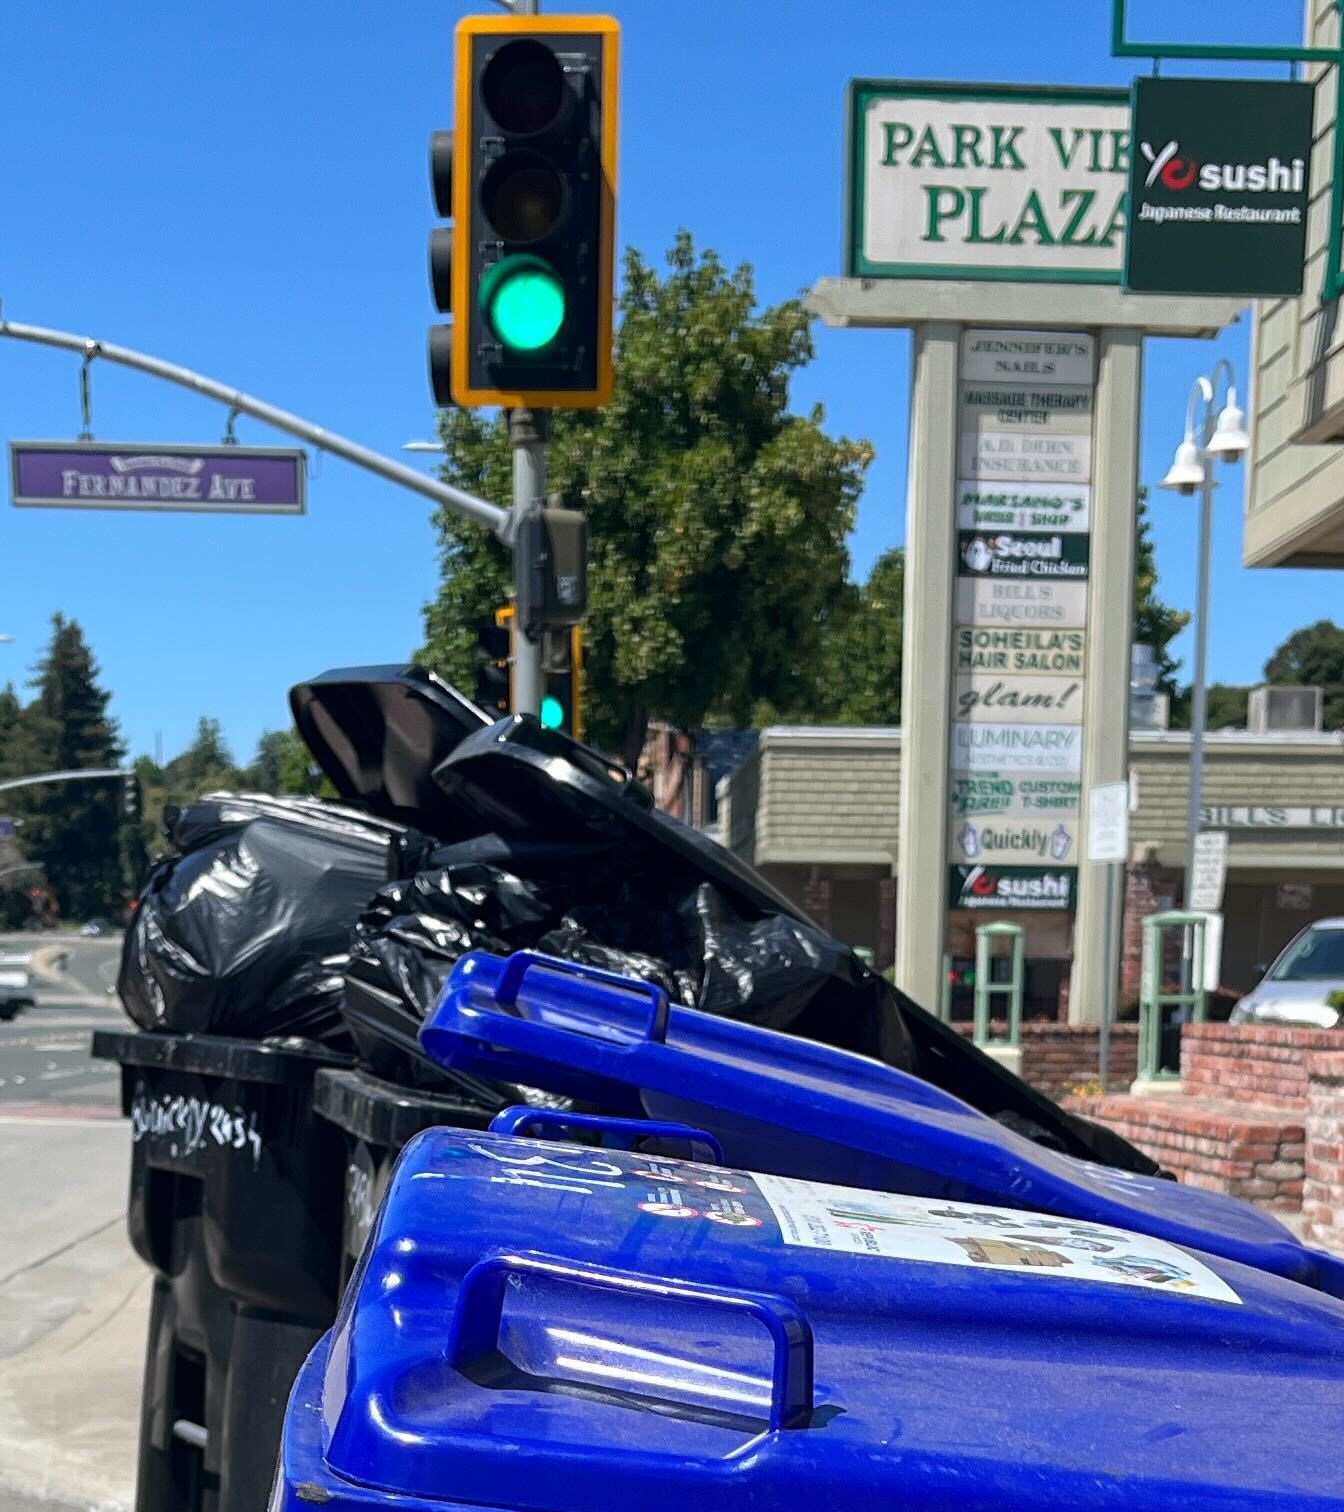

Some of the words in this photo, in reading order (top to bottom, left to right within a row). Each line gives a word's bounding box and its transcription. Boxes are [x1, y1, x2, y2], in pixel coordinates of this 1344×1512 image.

[881, 122, 1026, 171] PARK
[1050, 128, 1130, 171] VIE
[1199, 157, 1304, 192] sushi
[922, 186, 1127, 247] PLAZA
[1138, 203, 1213, 224] Japanese
[1214, 203, 1302, 224] Restaurant
[995, 361, 1056, 374] NAILS
[971, 456, 1082, 474] INSURANCE
[995, 535, 1062, 559] Seoul
[991, 559, 1029, 574] Fried
[1030, 560, 1087, 575] Chicken
[992, 584, 1054, 600] BILLS
[980, 604, 1065, 621] LIQUORS
[959, 631, 1082, 651] SOHEILA'S
[959, 651, 1007, 668] HAIR
[1014, 652, 1081, 670] SALON
[957, 681, 1078, 716] glam!
[957, 728, 1076, 749] LUMINARY
[959, 780, 1013, 796] TREND
[1019, 781, 1082, 794] CUSTOM
[981, 828, 1047, 857] Quickly
[996, 872, 1071, 897] sushi
